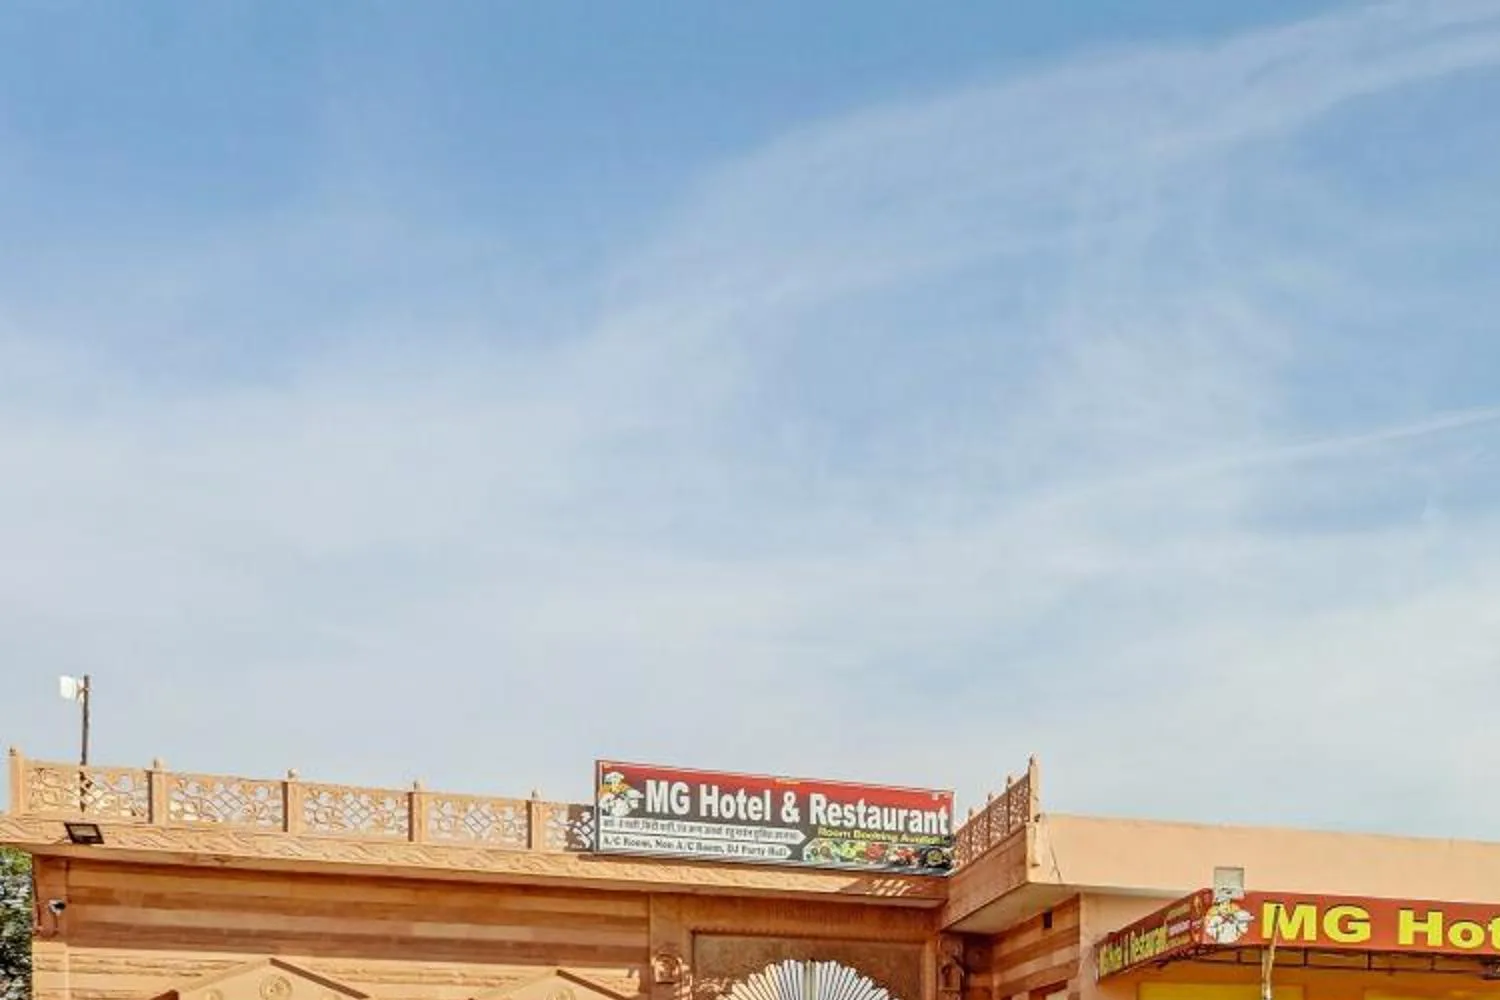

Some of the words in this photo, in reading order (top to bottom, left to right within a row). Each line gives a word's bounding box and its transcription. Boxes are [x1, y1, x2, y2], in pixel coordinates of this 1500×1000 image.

[644, 779, 691, 815] MG
[700, 784, 772, 822] Hotel
[780, 790, 800, 824] &
[809, 793, 949, 836] Restaurant
[1263, 902, 1371, 943] MG
